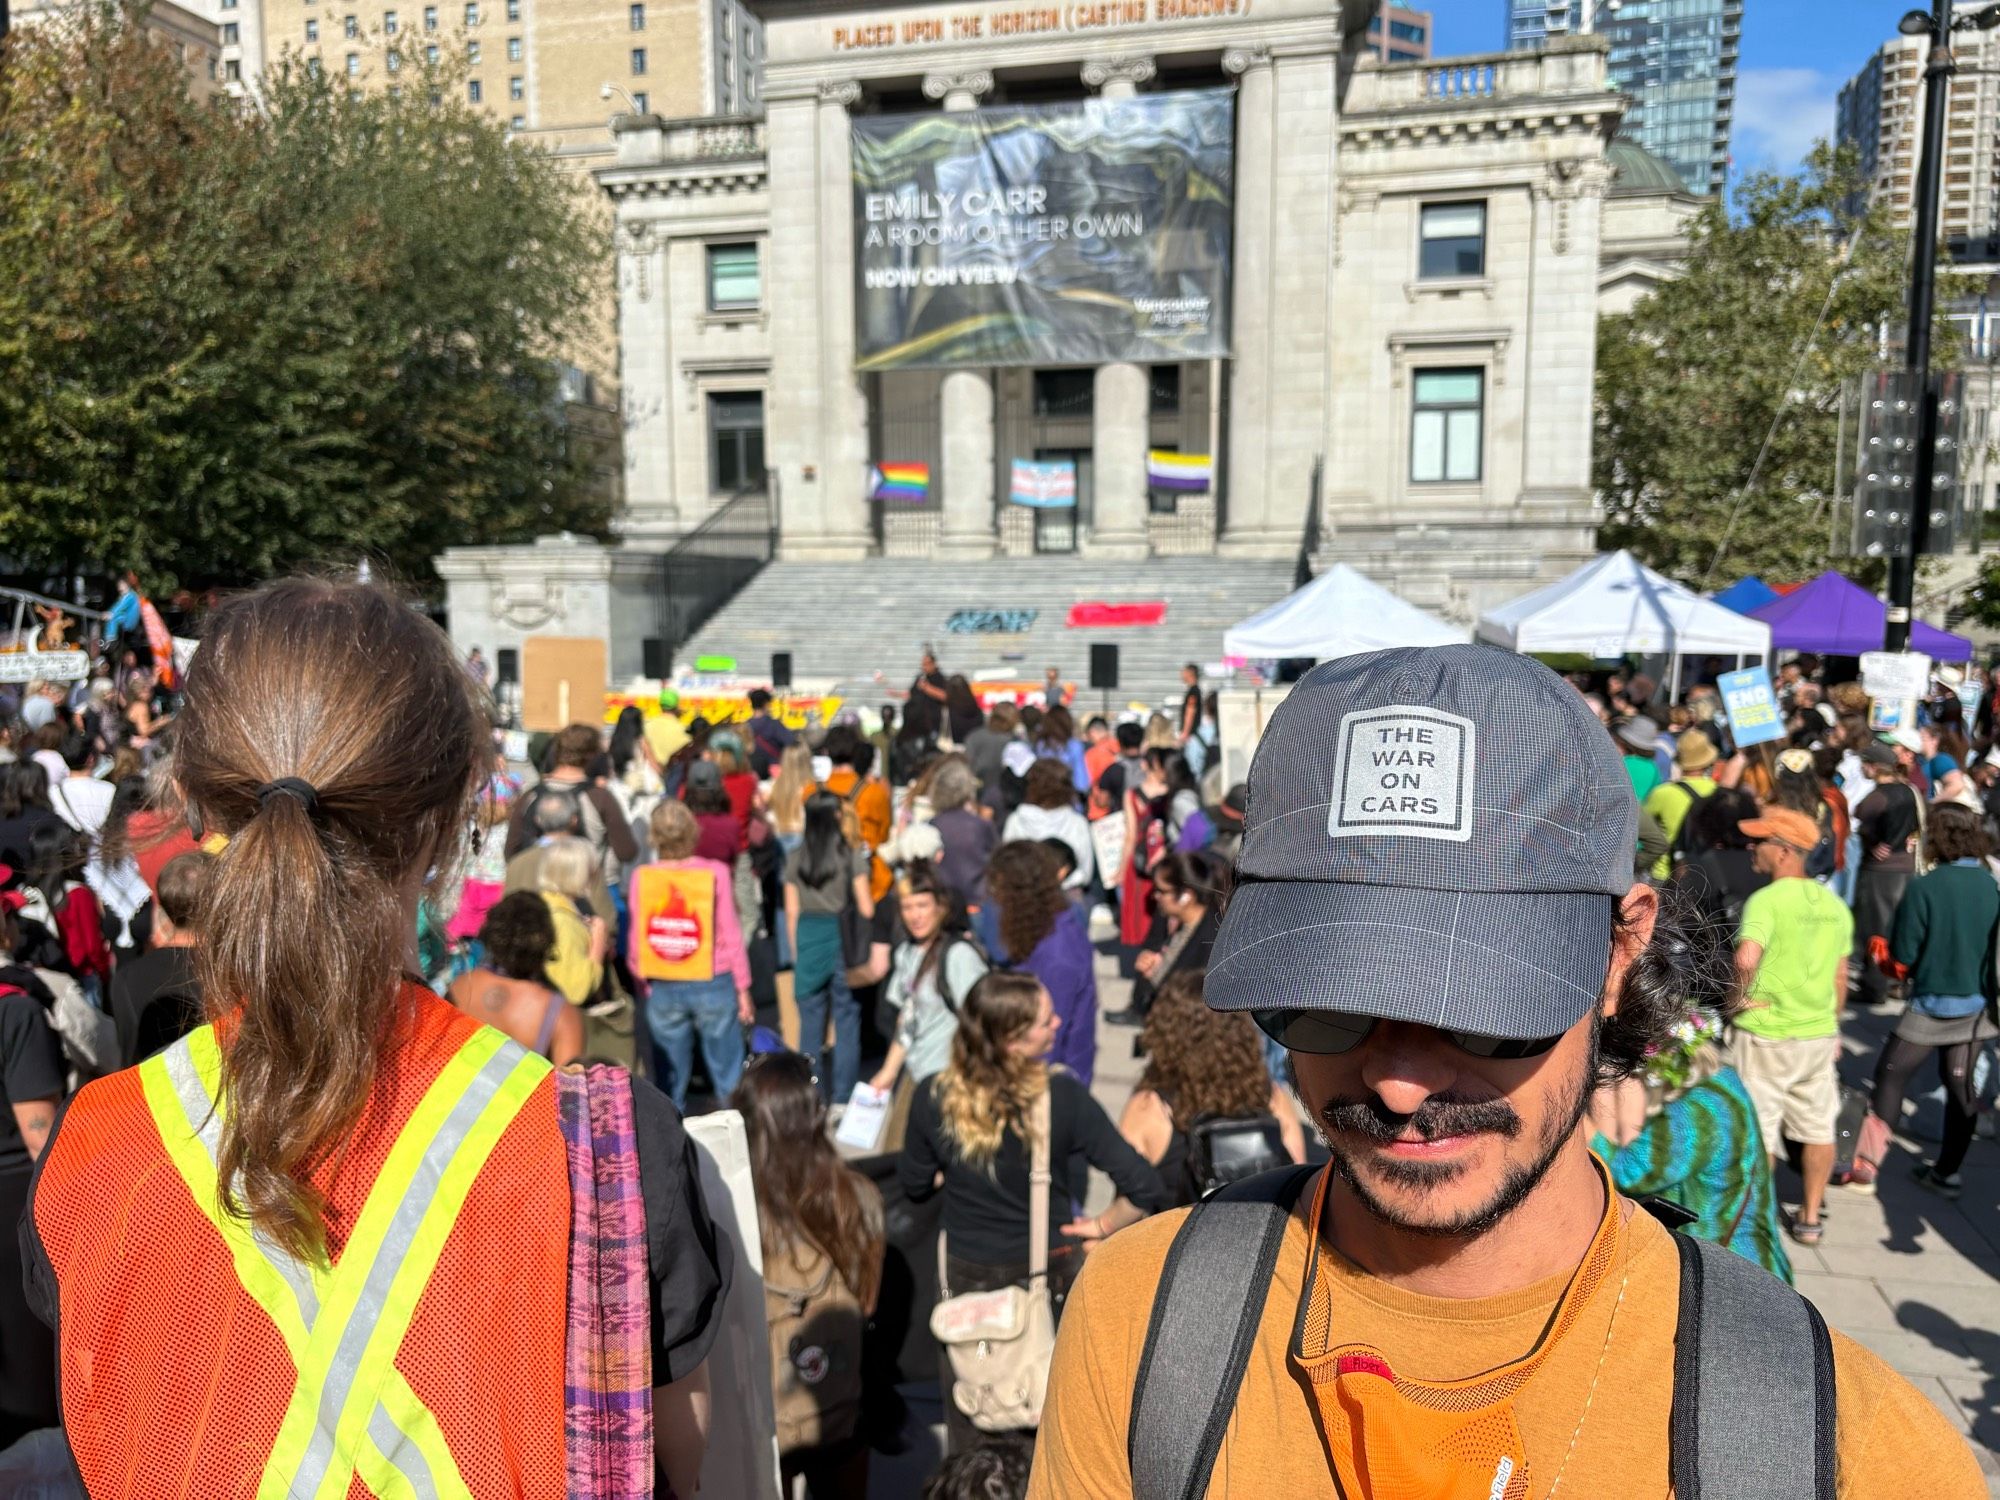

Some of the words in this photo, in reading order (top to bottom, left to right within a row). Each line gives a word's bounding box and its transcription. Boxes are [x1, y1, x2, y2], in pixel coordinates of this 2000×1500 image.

[901, 17, 944, 44] UPON
[950, 15, 983, 40] THE
[864, 190, 955, 222] EMILY
[961, 185, 1048, 218] CARR
[863, 225, 884, 249] A
[889, 221, 968, 247] ROOM
[972, 219, 1008, 244] OF
[1014, 215, 1068, 243] HER
[1072, 211, 1144, 239] OWN
[864, 266, 920, 290] NOW
[922, 265, 955, 287] ON
[957, 263, 1020, 286] VIEW
[1377, 727, 1434, 745] THE
[1371, 749, 1436, 768] WAR
[1380, 772, 1421, 790] ON
[1360, 796, 1439, 815] CARS
